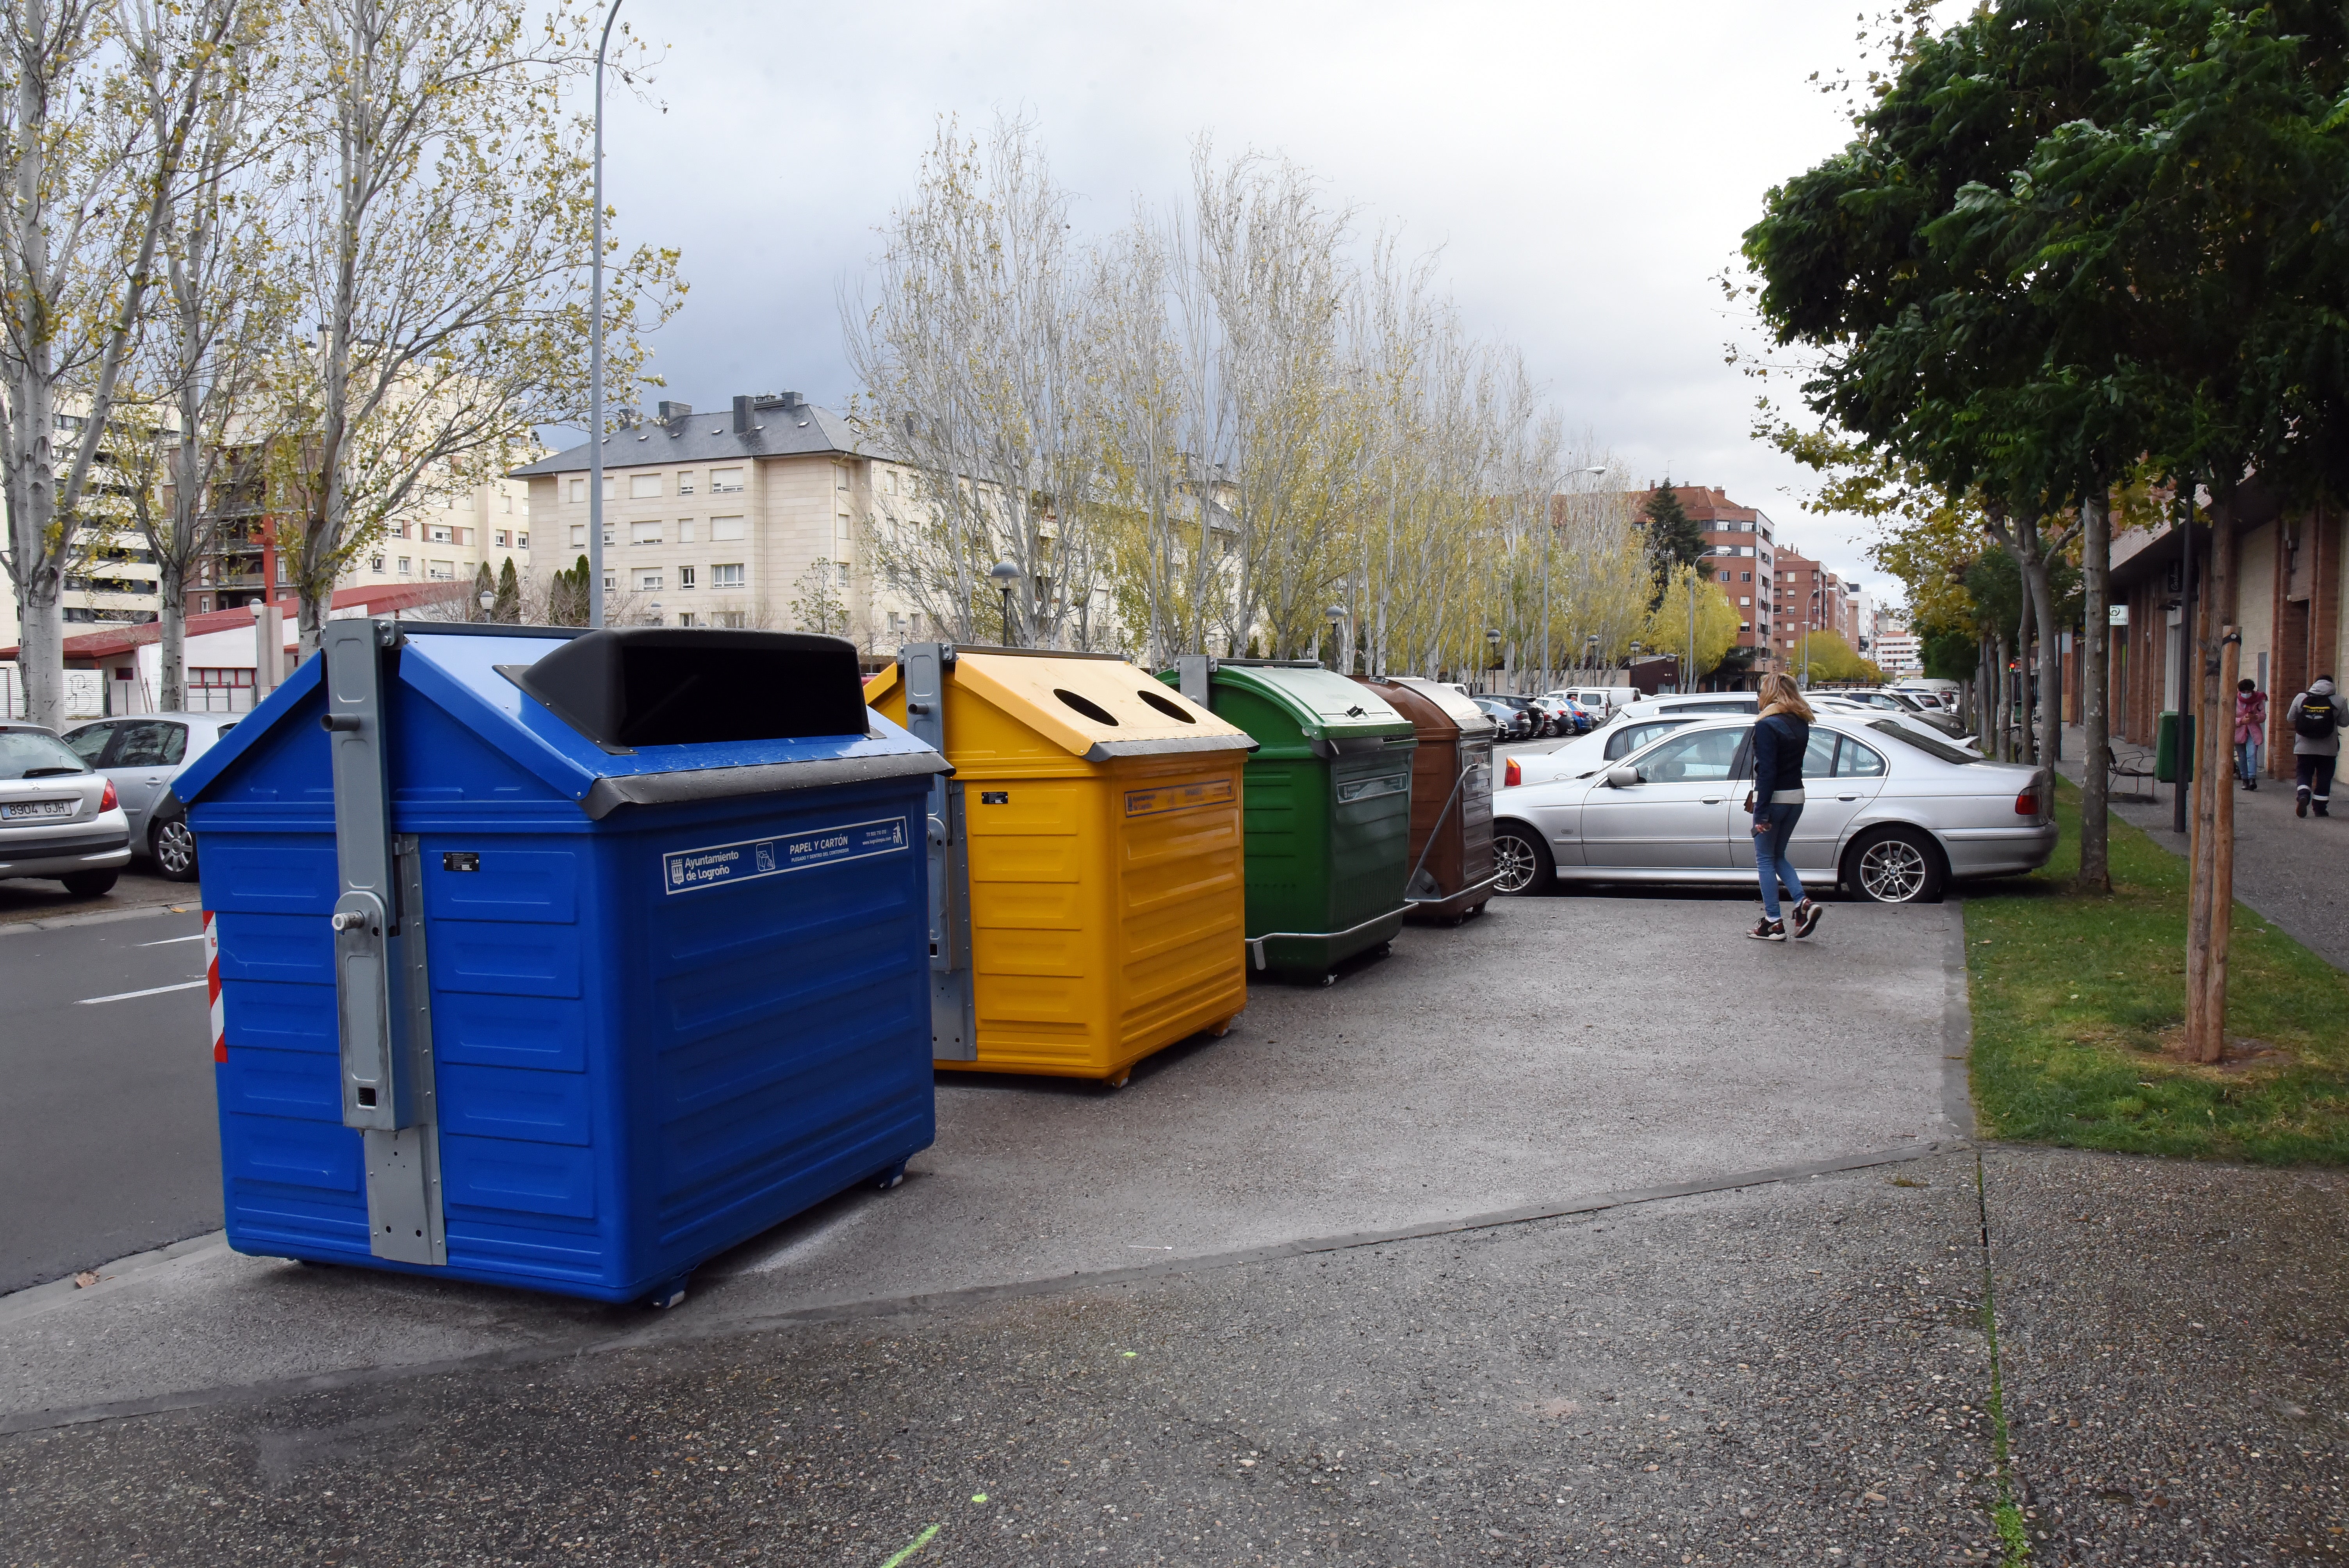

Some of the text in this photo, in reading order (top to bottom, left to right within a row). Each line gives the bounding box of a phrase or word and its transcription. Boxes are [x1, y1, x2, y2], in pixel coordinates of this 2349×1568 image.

[9, 802, 65, 815] 8904 GJH
[790, 833, 848, 854] PAPEL Y CARTÓN
[685, 850, 739, 870] Ayuntamiento
[686, 864, 730, 881] de Logroño
